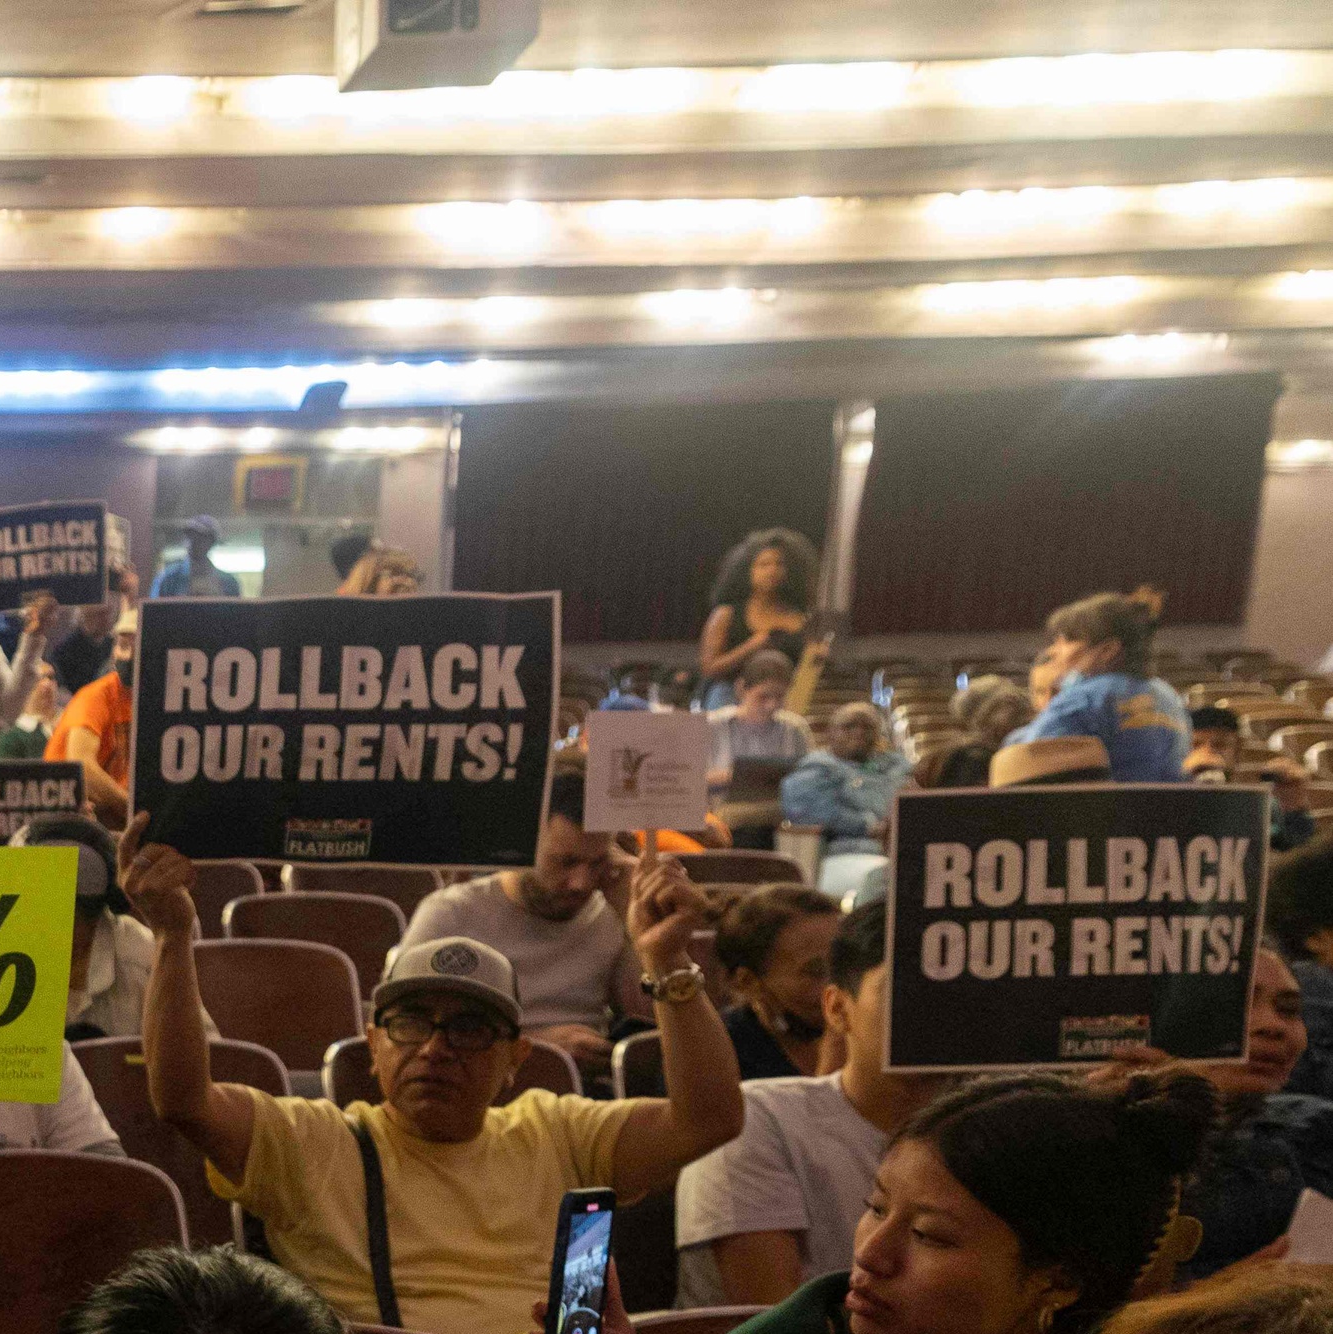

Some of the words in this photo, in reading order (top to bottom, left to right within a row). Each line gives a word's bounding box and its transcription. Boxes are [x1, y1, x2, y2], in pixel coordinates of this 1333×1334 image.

[164, 643, 527, 714] ROLLBACK
[159, 723, 285, 784] OUR
[299, 720, 522, 781] RENTS!
[923, 835, 1251, 910] ROLLBACK
[920, 918, 1055, 982] OUR
[1069, 914, 1245, 978] RENTS!
